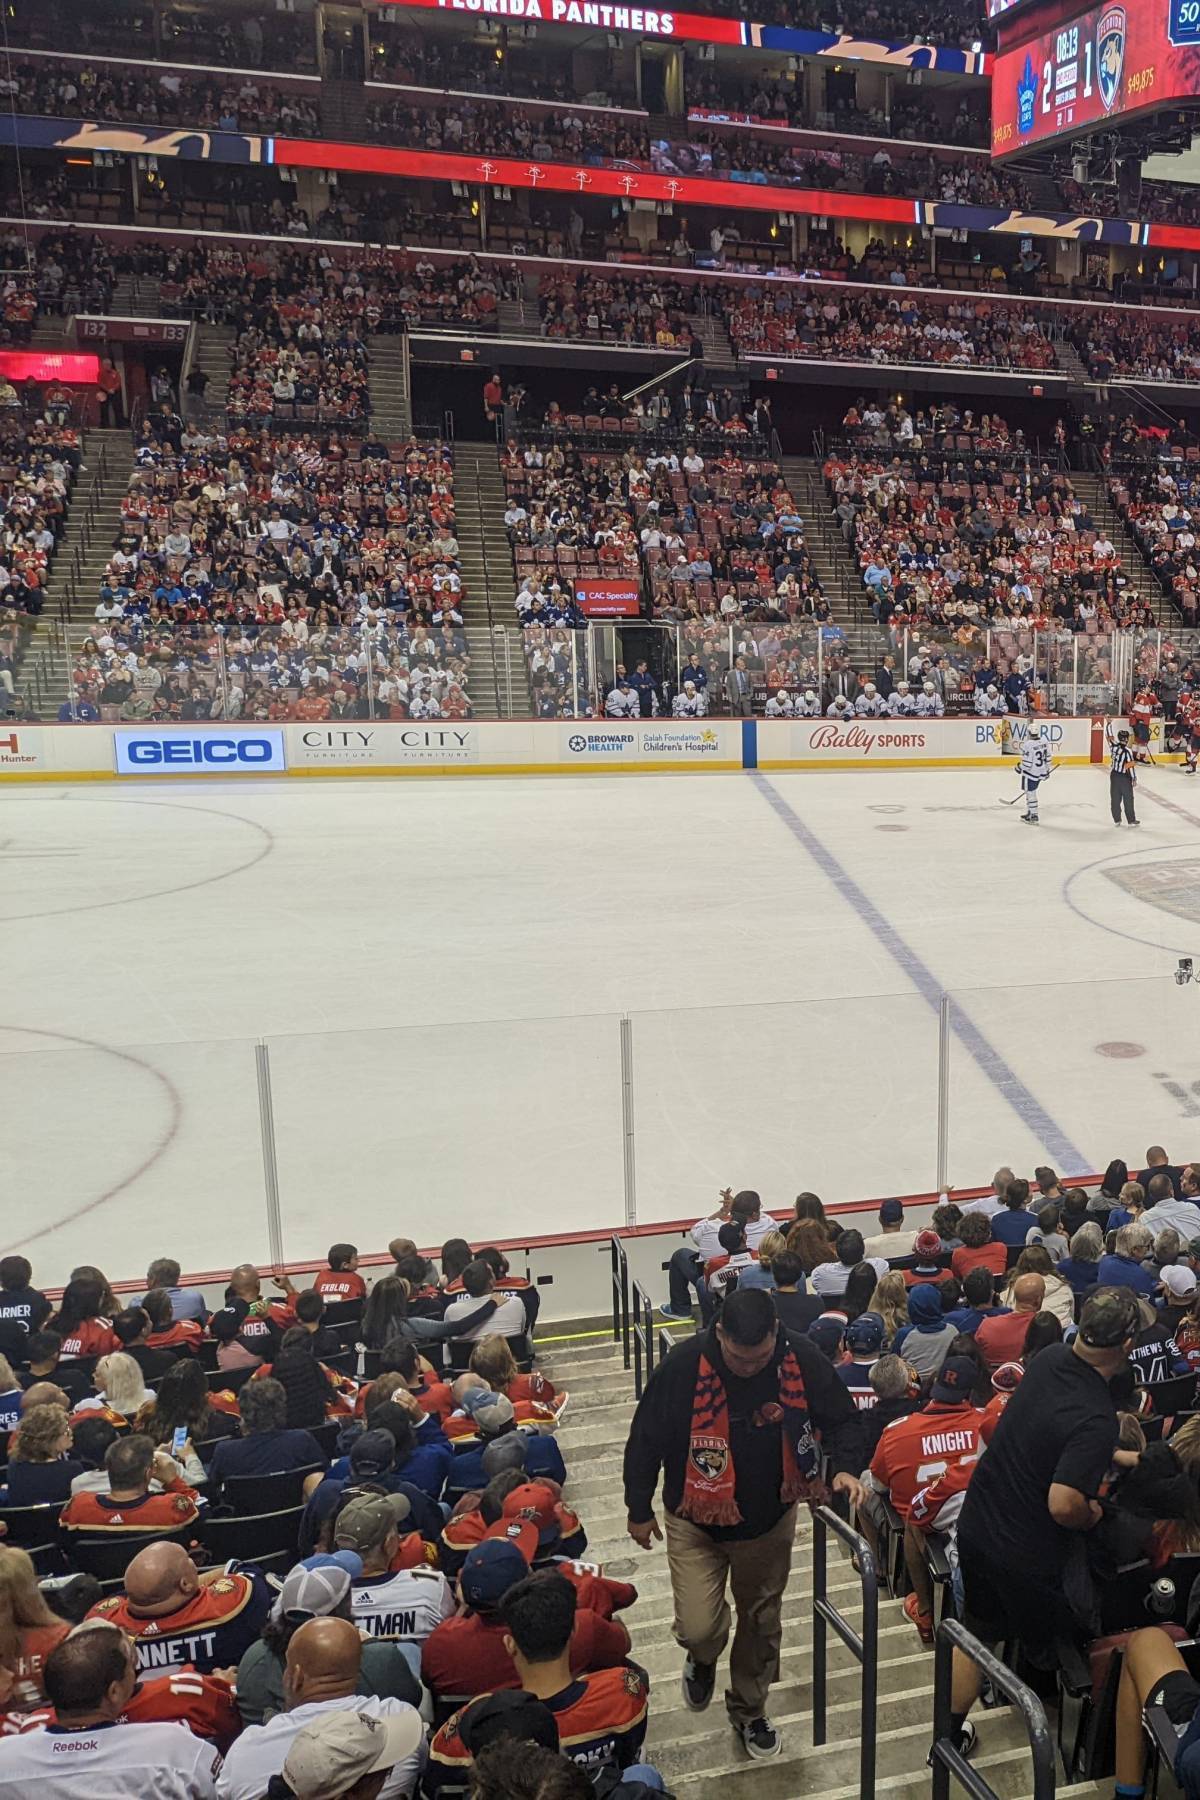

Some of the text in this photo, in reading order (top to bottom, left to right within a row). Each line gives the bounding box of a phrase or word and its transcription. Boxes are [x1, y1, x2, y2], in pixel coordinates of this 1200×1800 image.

[438, 0, 675, 34] ORIDA PANTHERS
[1178, 2, 1199, 24] 50
[1100, 17, 1122, 35] FLORIDA
[1056, 27, 1079, 64] 08:13
[1084, 42, 1092, 98] 1
[1042, 61, 1052, 113] 2
[1127, 67, 1154, 96] $49,875
[84, 322, 185, 340] 132 133
[589, 592, 638, 601] CAC Specialty
[302, 731, 375, 747] CITY
[400, 731, 471, 747] CITY
[588, 735, 635, 743] BROWARD
[643, 734, 702, 742] Salah Foundation
[809, 724, 926, 755] Bally SPORTS
[127, 739, 273, 764] GEICO
[588, 743, 624, 752] HEALTH
[643, 742, 719, 753] Children's Hospital
[0, 754, 38, 764] Hunter
[320, 1283, 350, 1293] EKBLAD
[921, 1430, 974, 1456] KNIGHT
[52, 1739, 99, 1753] Reebok
